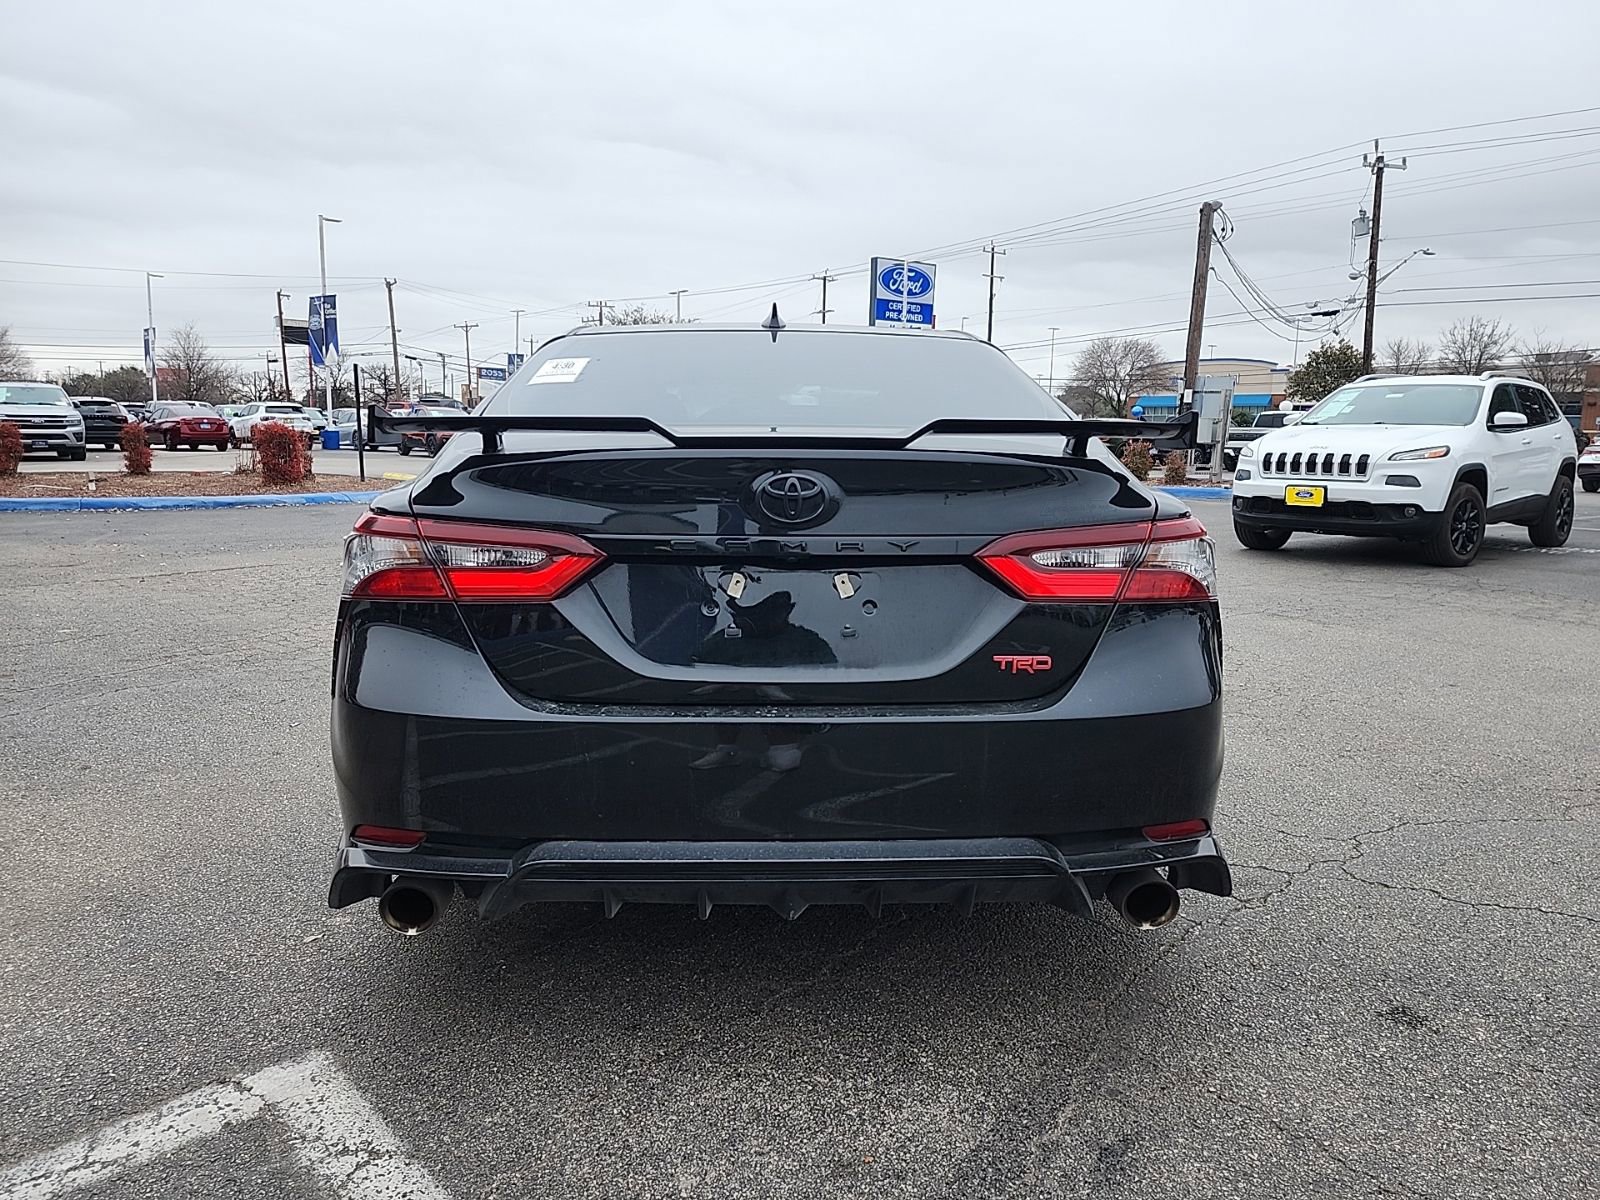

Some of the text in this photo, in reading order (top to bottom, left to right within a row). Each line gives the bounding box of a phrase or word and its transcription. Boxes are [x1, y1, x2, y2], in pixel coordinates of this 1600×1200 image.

[889, 269, 924, 293] Ford
[888, 302, 921, 313] CERFIED
[481, 369, 503, 377] ROSS
[669, 540, 920, 552] CAMRY
[993, 655, 1052, 674] TRD
